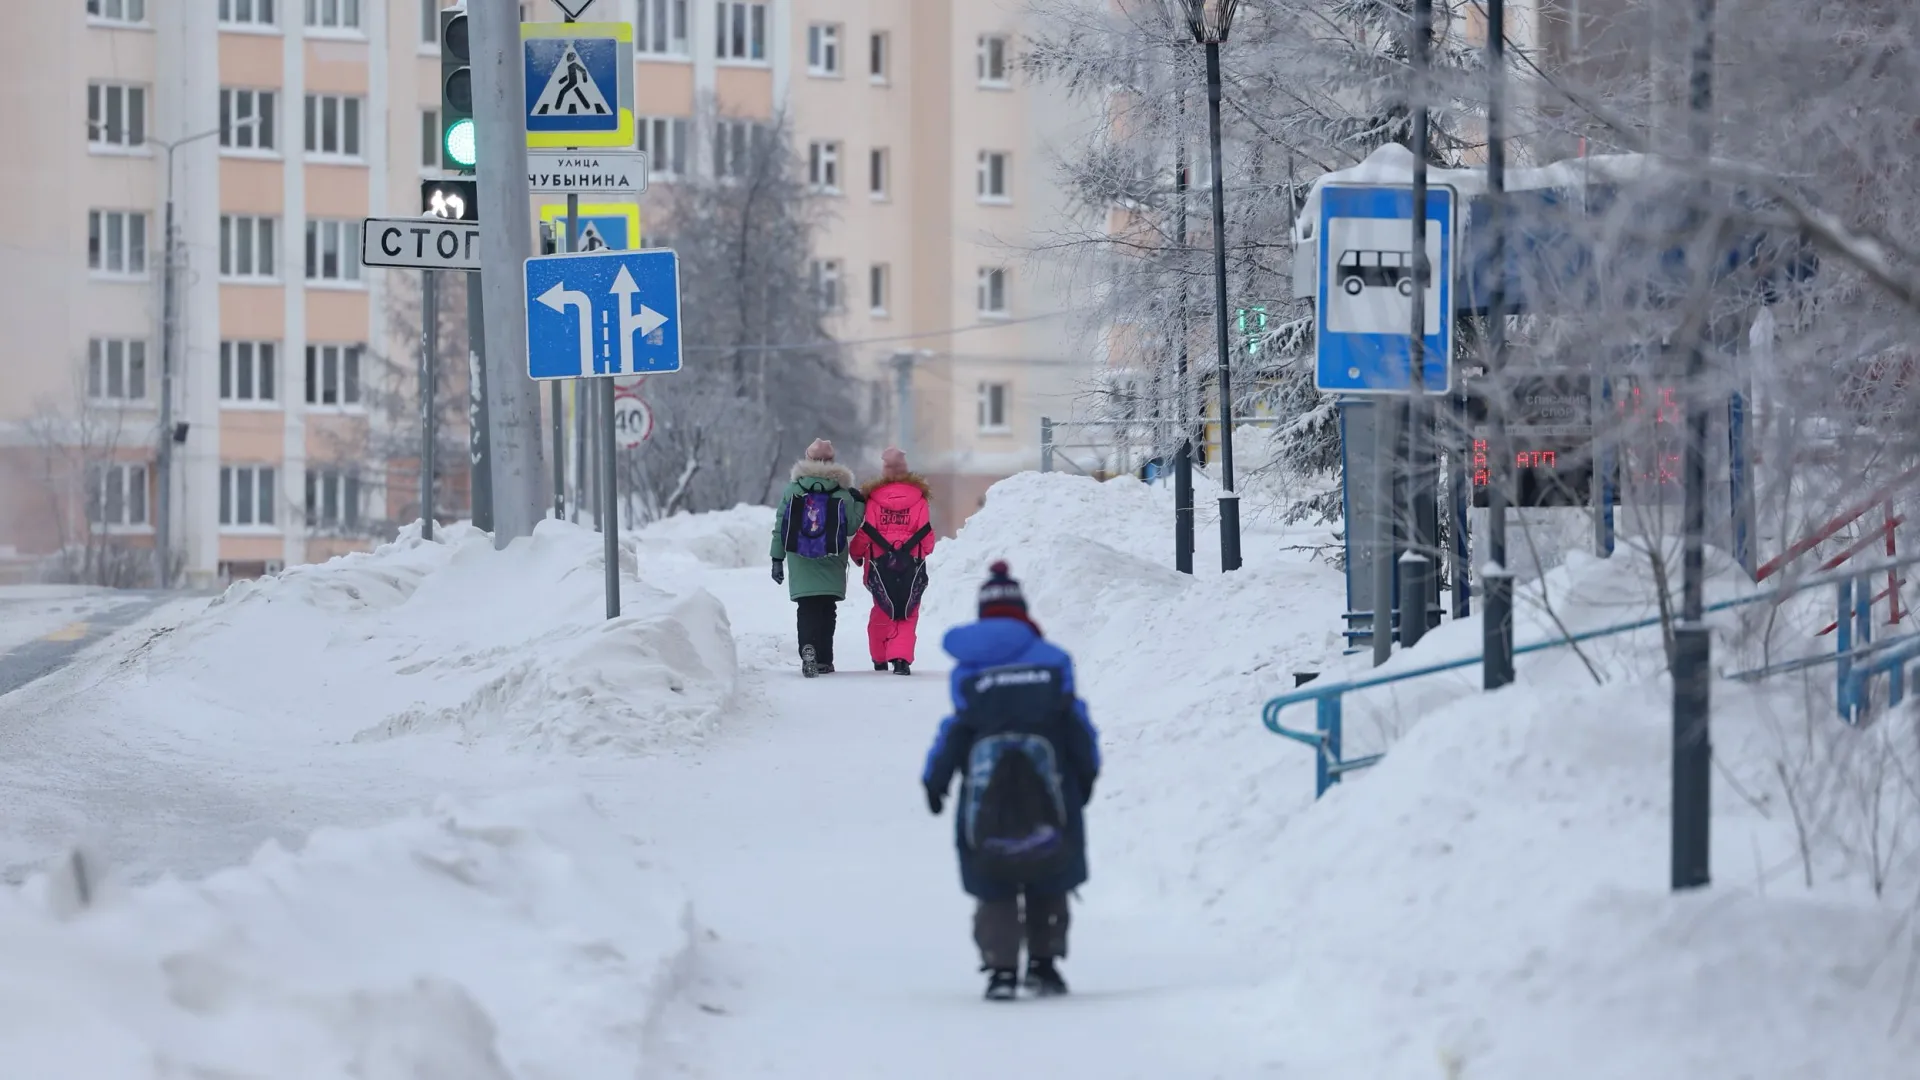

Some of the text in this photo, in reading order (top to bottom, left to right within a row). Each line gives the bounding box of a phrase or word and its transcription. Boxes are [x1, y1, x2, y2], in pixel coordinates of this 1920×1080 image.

[558, 159, 599, 168] УЛИЦА
[528, 174, 630, 187] ЧУБЫНИНА
[615, 408, 643, 434] 40
[1517, 451, 1555, 468] АТП
